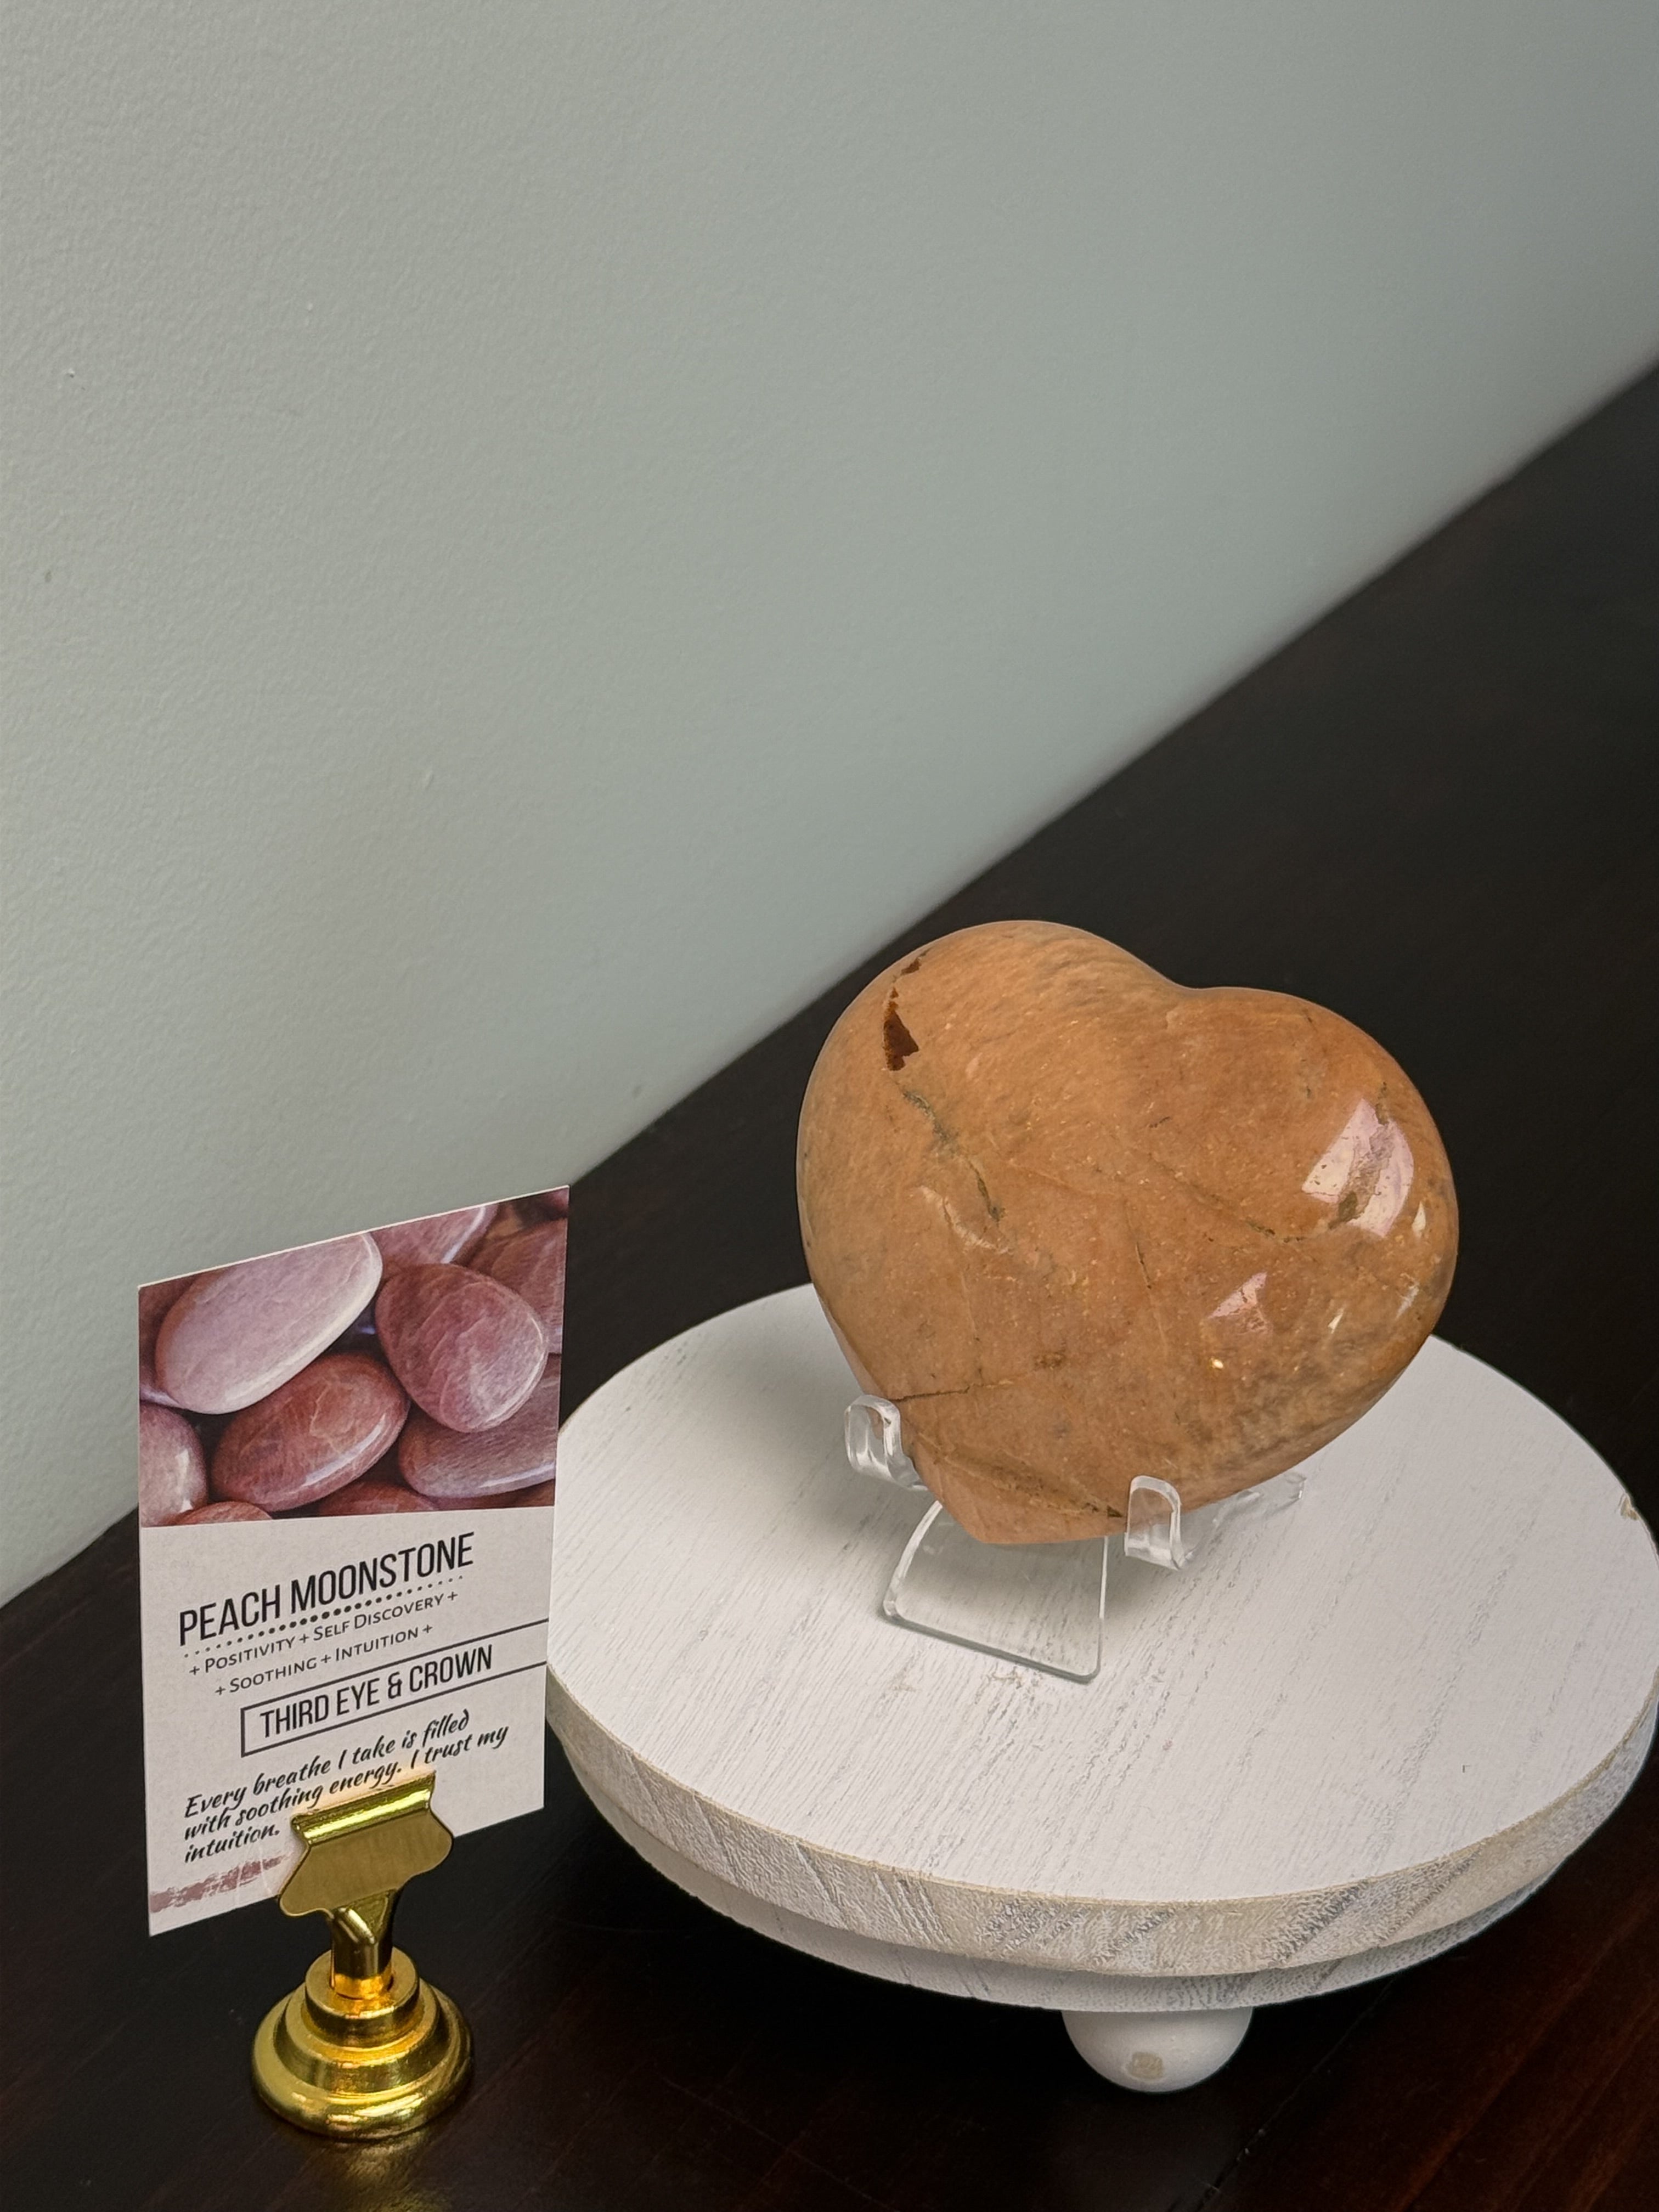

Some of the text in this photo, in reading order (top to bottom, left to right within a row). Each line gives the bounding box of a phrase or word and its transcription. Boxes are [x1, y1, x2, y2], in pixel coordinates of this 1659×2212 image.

[179, 1531, 475, 1646] PEACH MOONSTONE
[205, 1635, 294, 1674] POSITIVITY
[313, 1621, 351, 1641] SELF
[354, 1593, 444, 1630] DISCOVERY
[229, 1657, 317, 1694] SOOTHING
[336, 1627, 419, 1661] INTUITION
[259, 1644, 493, 1738] THIRD EYE & CROWN
[184, 1709, 469, 1818] Every breathe I take is filled
[184, 1726, 509, 1840] with soothing energy. I trust my
[184, 1825, 280, 1863] intuition.
